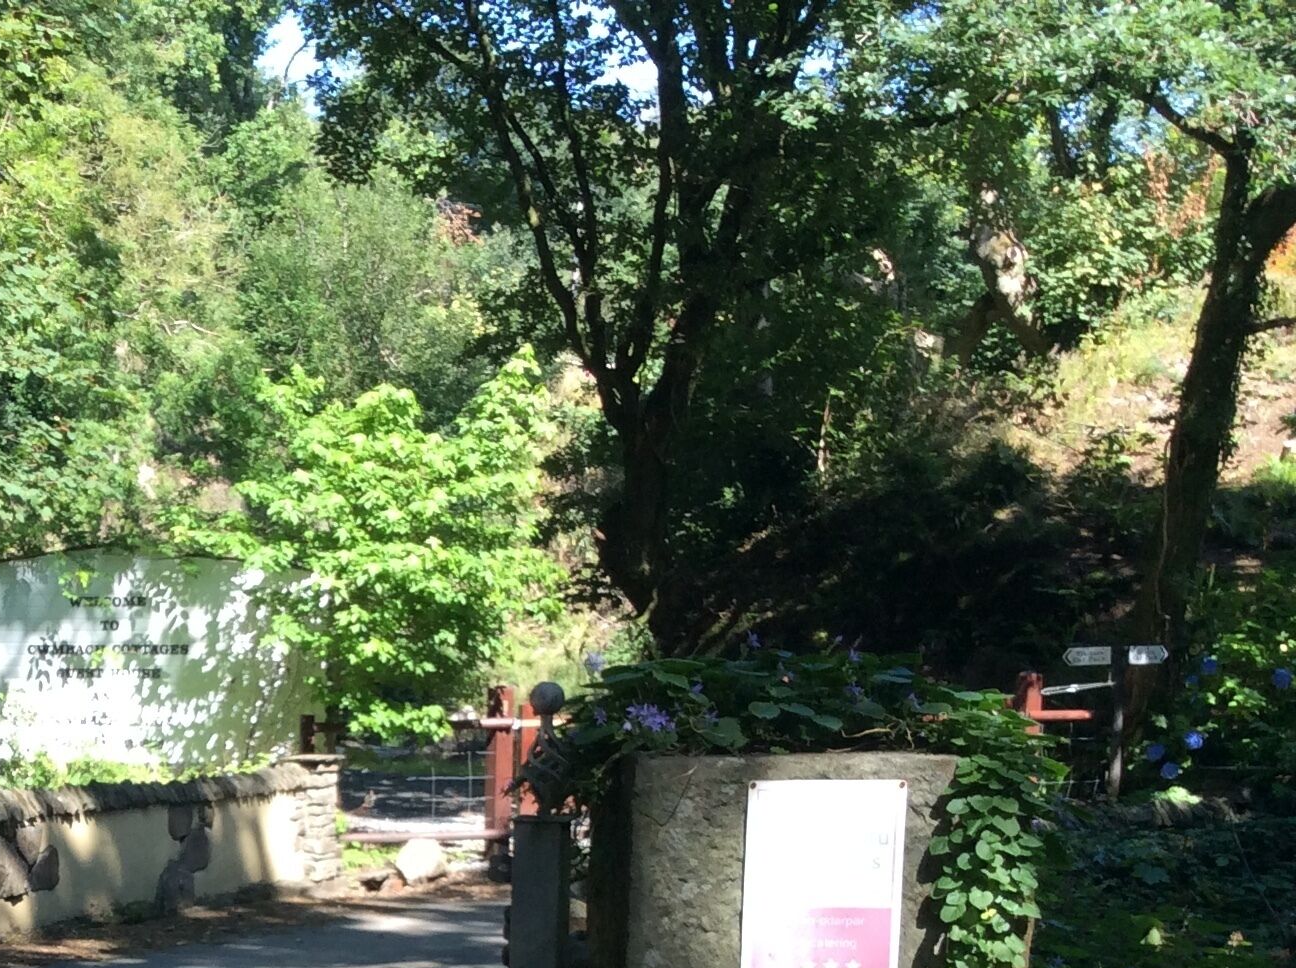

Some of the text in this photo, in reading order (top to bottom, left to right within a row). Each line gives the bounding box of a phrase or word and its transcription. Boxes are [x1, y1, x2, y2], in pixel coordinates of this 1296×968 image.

[100, 620, 120, 631] TO
[111, 644, 190, 655] COTTAGES
[56, 668, 162, 679] GUEST HSE
